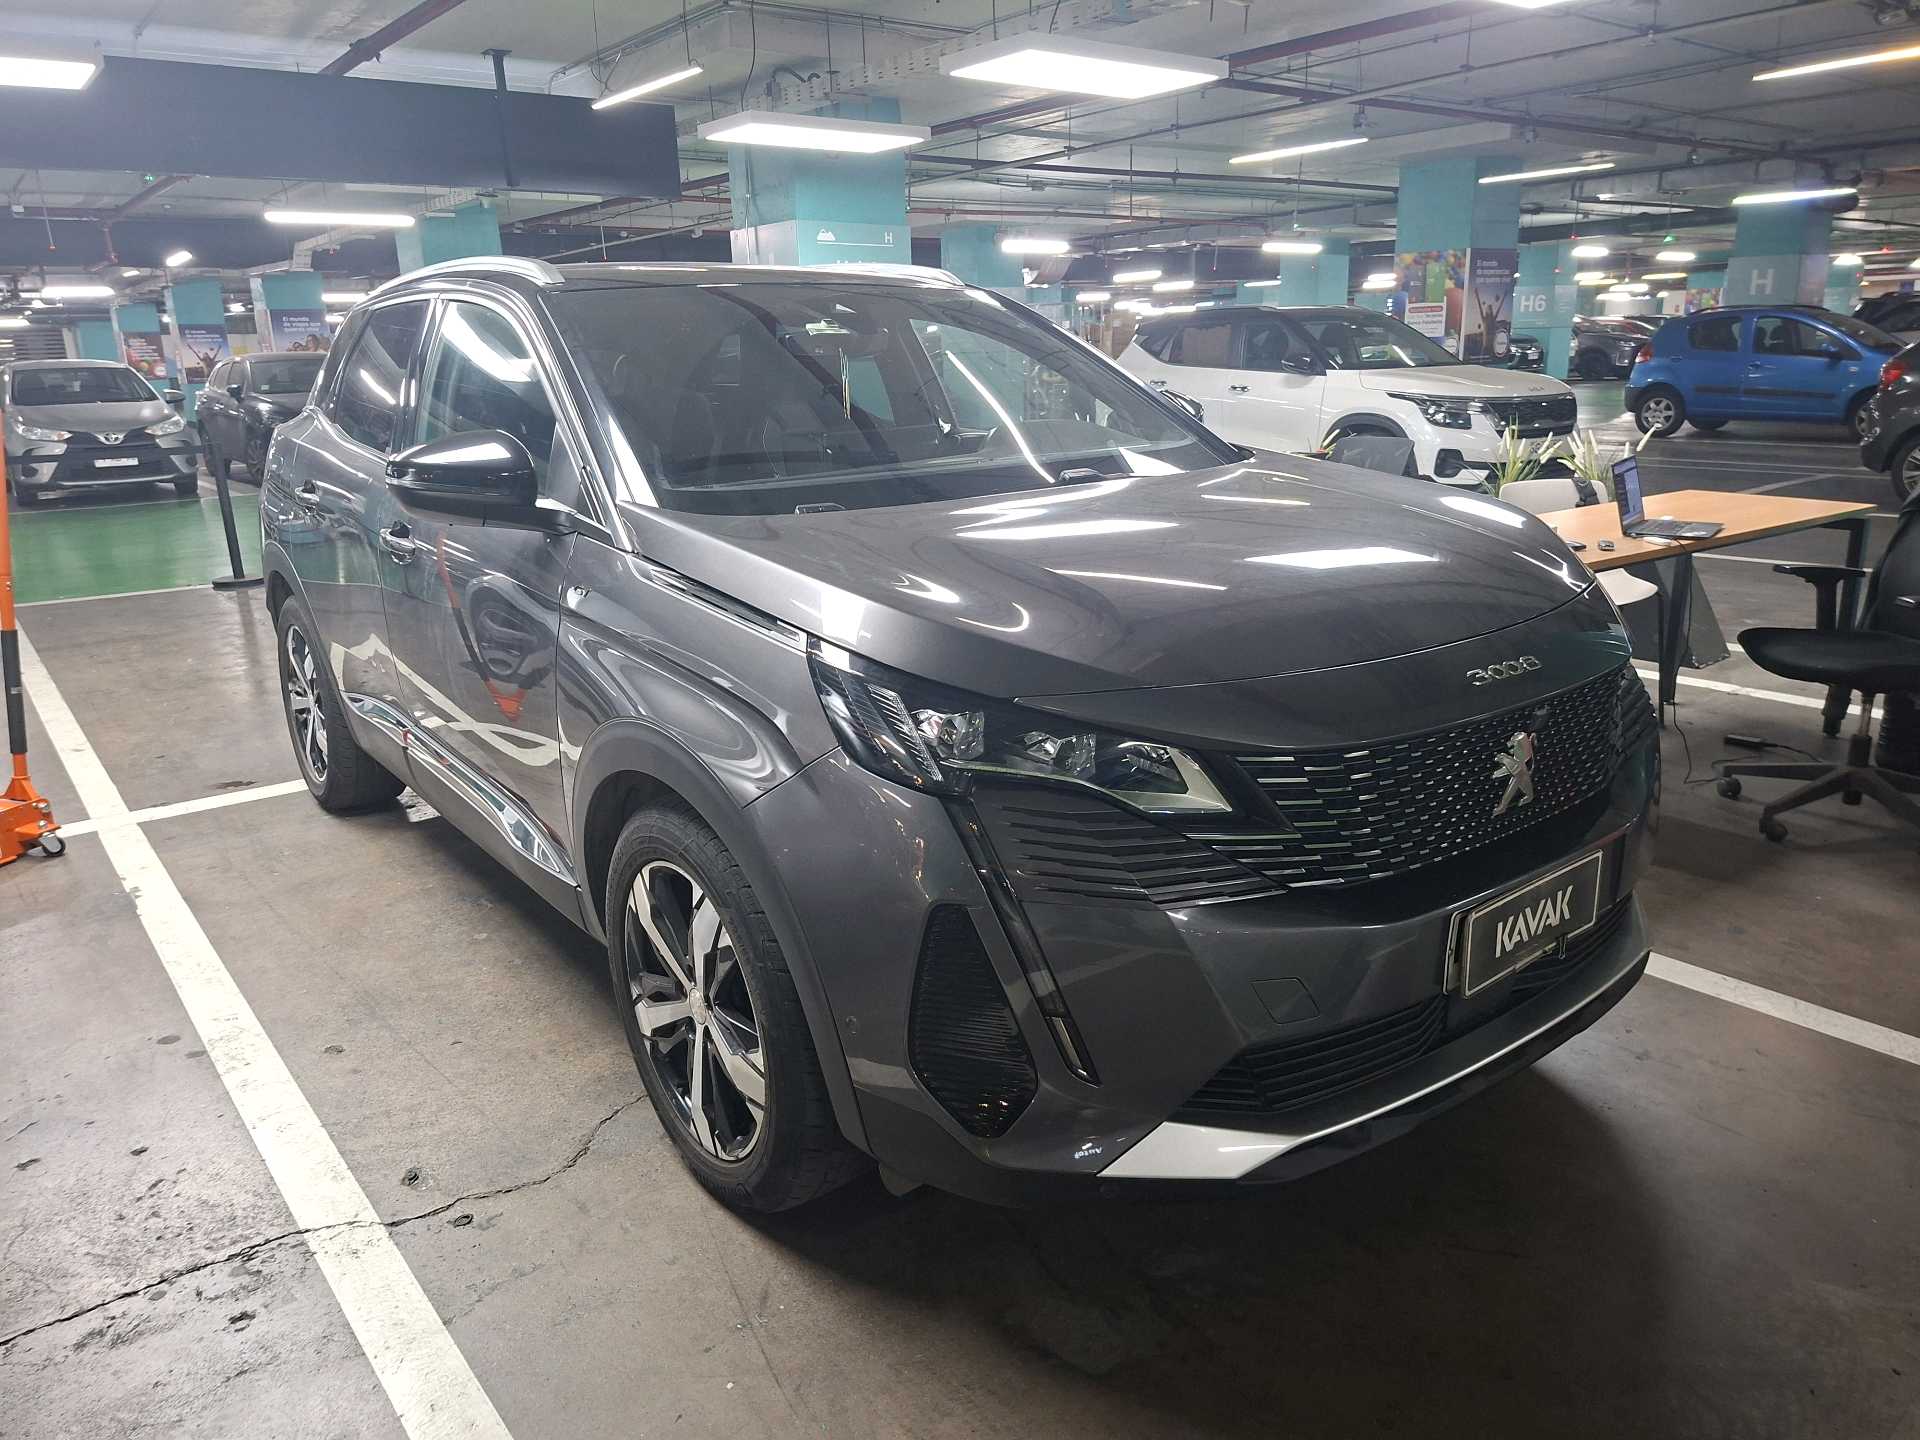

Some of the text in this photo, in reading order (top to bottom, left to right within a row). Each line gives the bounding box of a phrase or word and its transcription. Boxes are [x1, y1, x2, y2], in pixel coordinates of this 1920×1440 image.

[884, 231, 893, 244] H
[1750, 268, 1775, 295] H
[1518, 293, 1547, 313] H6
[1466, 655, 1543, 686] 3008
[1495, 884, 1574, 959] KAVAK
